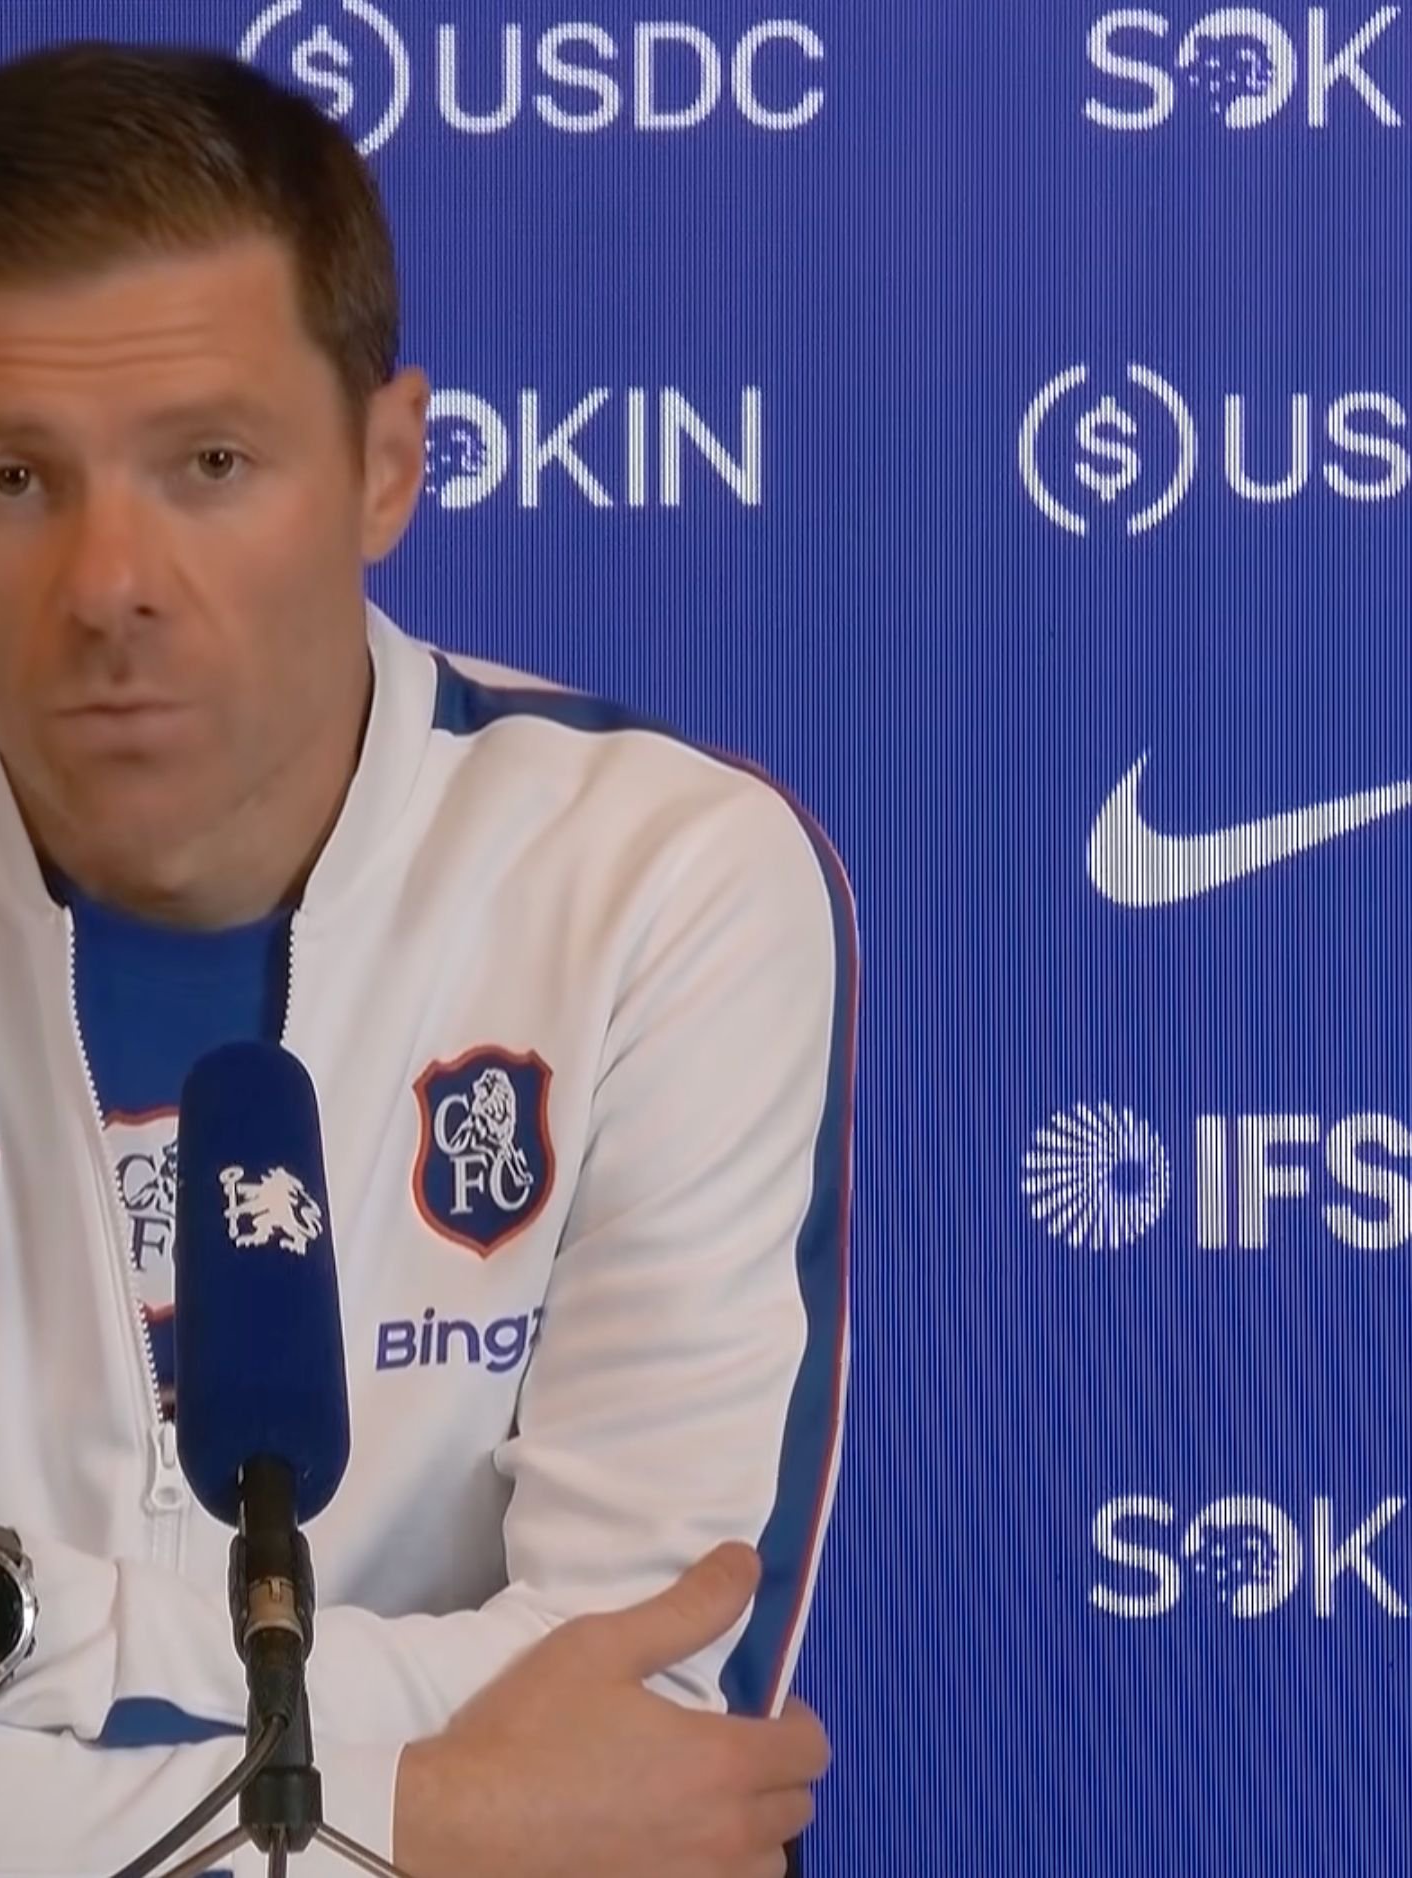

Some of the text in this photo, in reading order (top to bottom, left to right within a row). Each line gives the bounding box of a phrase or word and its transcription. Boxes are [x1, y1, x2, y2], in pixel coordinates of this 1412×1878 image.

[438, 20, 825, 133] USDC
[424, 386, 763, 509] OKIN
[1224, 392, 1412, 502] US
[1197, 1111, 1412, 1250] IFS
[376, 1306, 545, 1373] Bing
